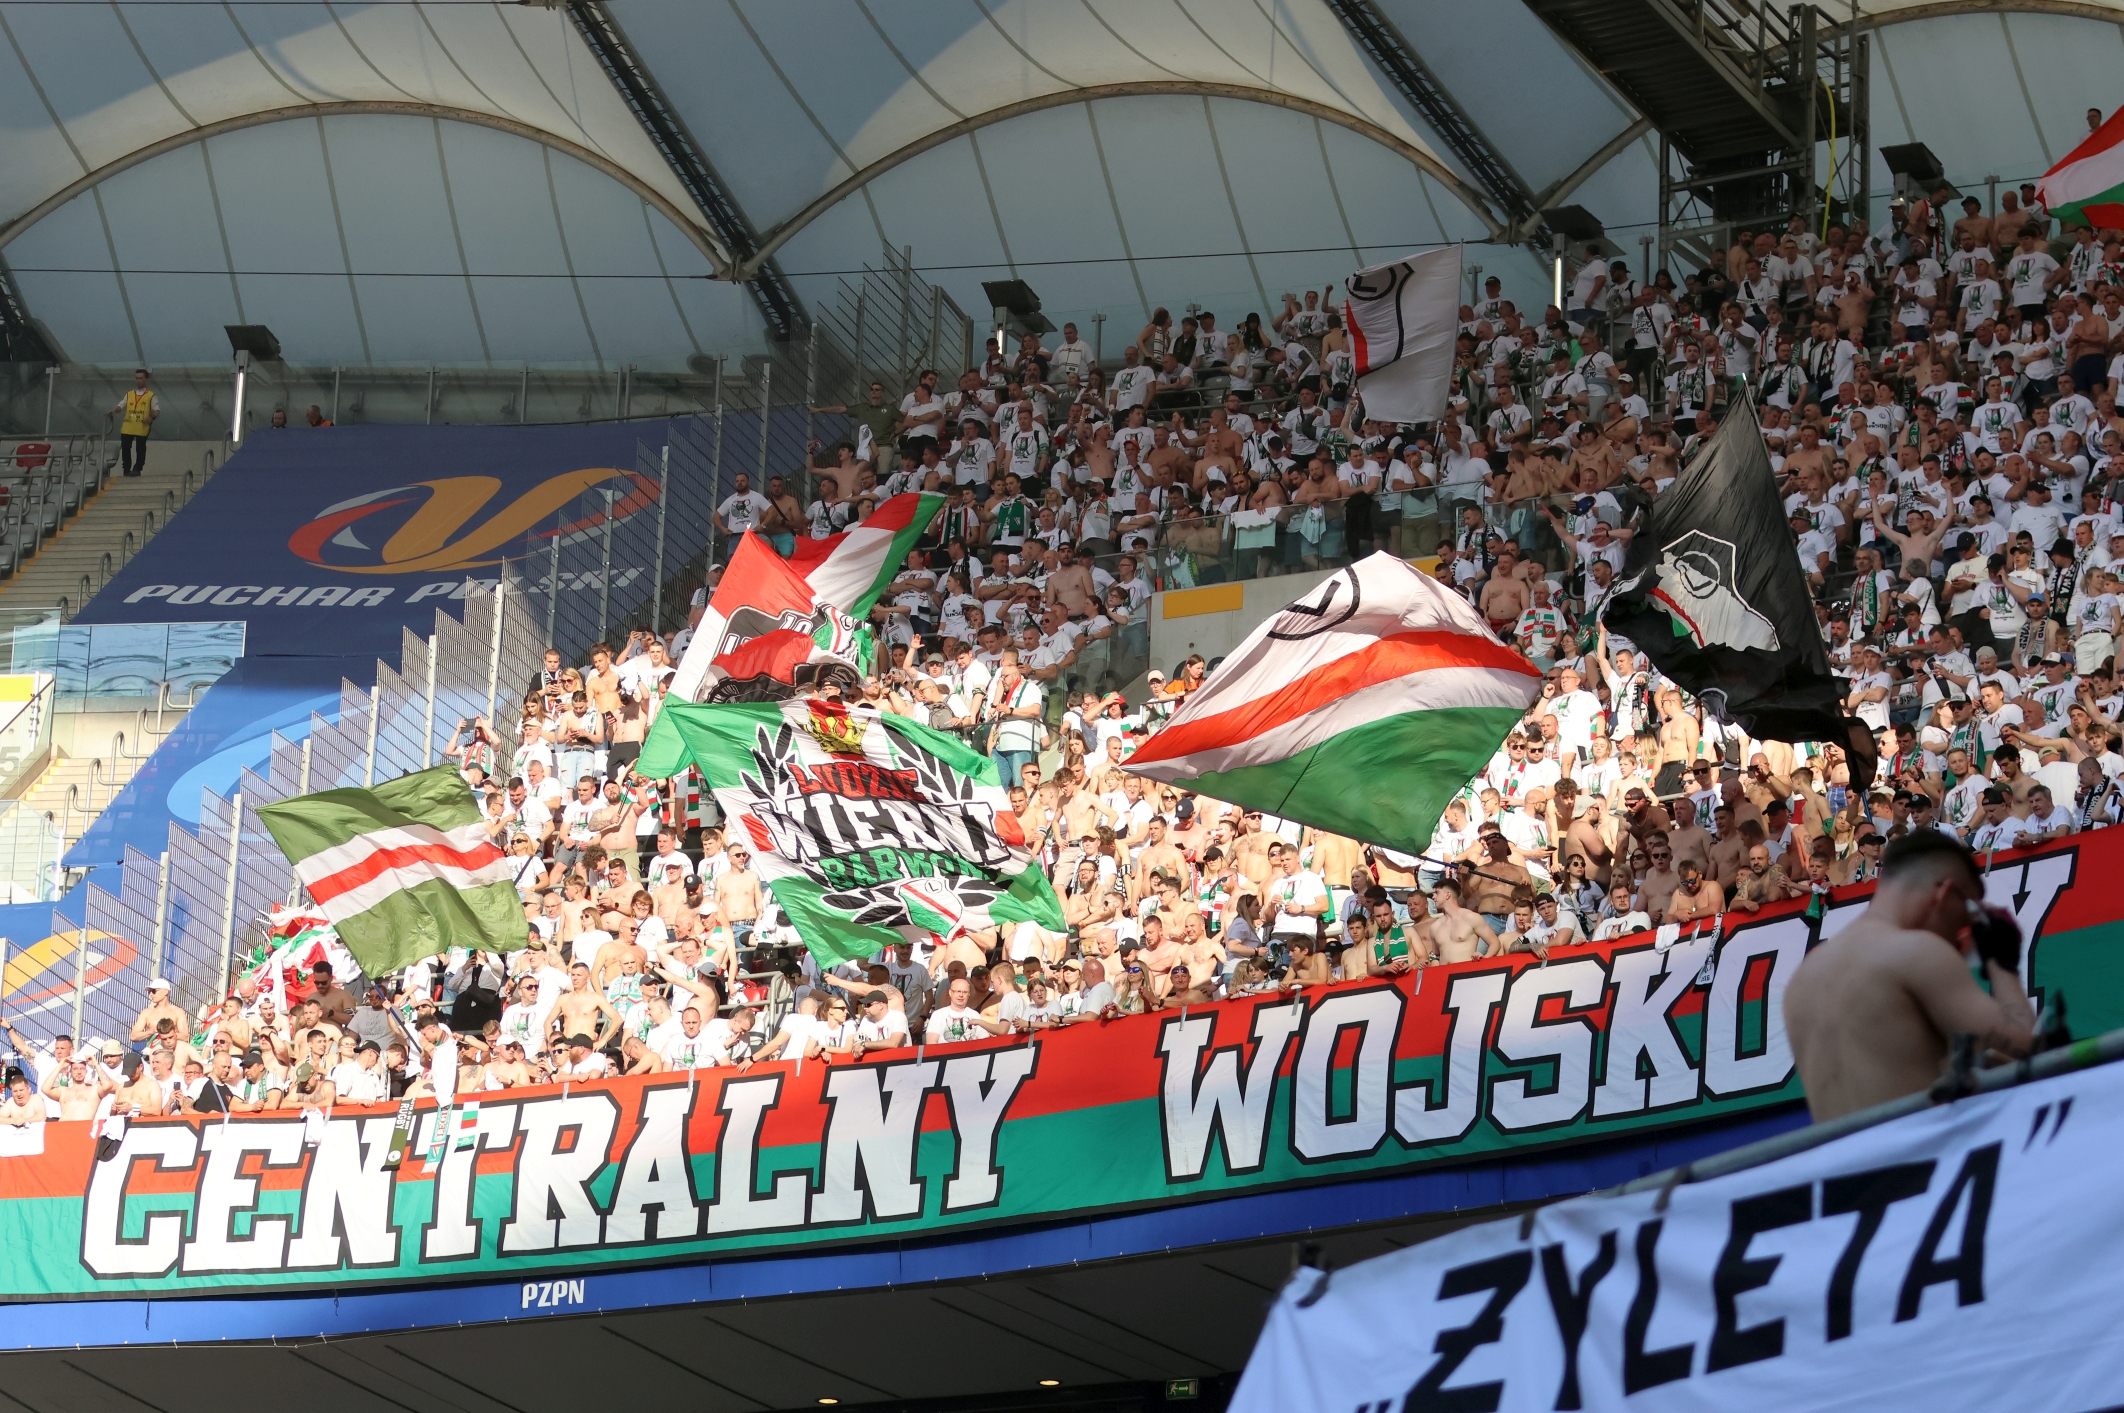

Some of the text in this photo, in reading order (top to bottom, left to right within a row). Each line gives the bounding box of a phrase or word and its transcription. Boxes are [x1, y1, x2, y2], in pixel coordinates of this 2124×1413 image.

[123, 567, 645, 606] PUCHAR POLSKI
[788, 762, 923, 800] LUDZIE
[750, 793, 1012, 864] WIERNI
[81, 844, 2080, 1278] CENTRALNY WOJSKOY
[395, 1103, 407, 1129] RUGBY
[521, 1278, 586, 1308] PZPN
